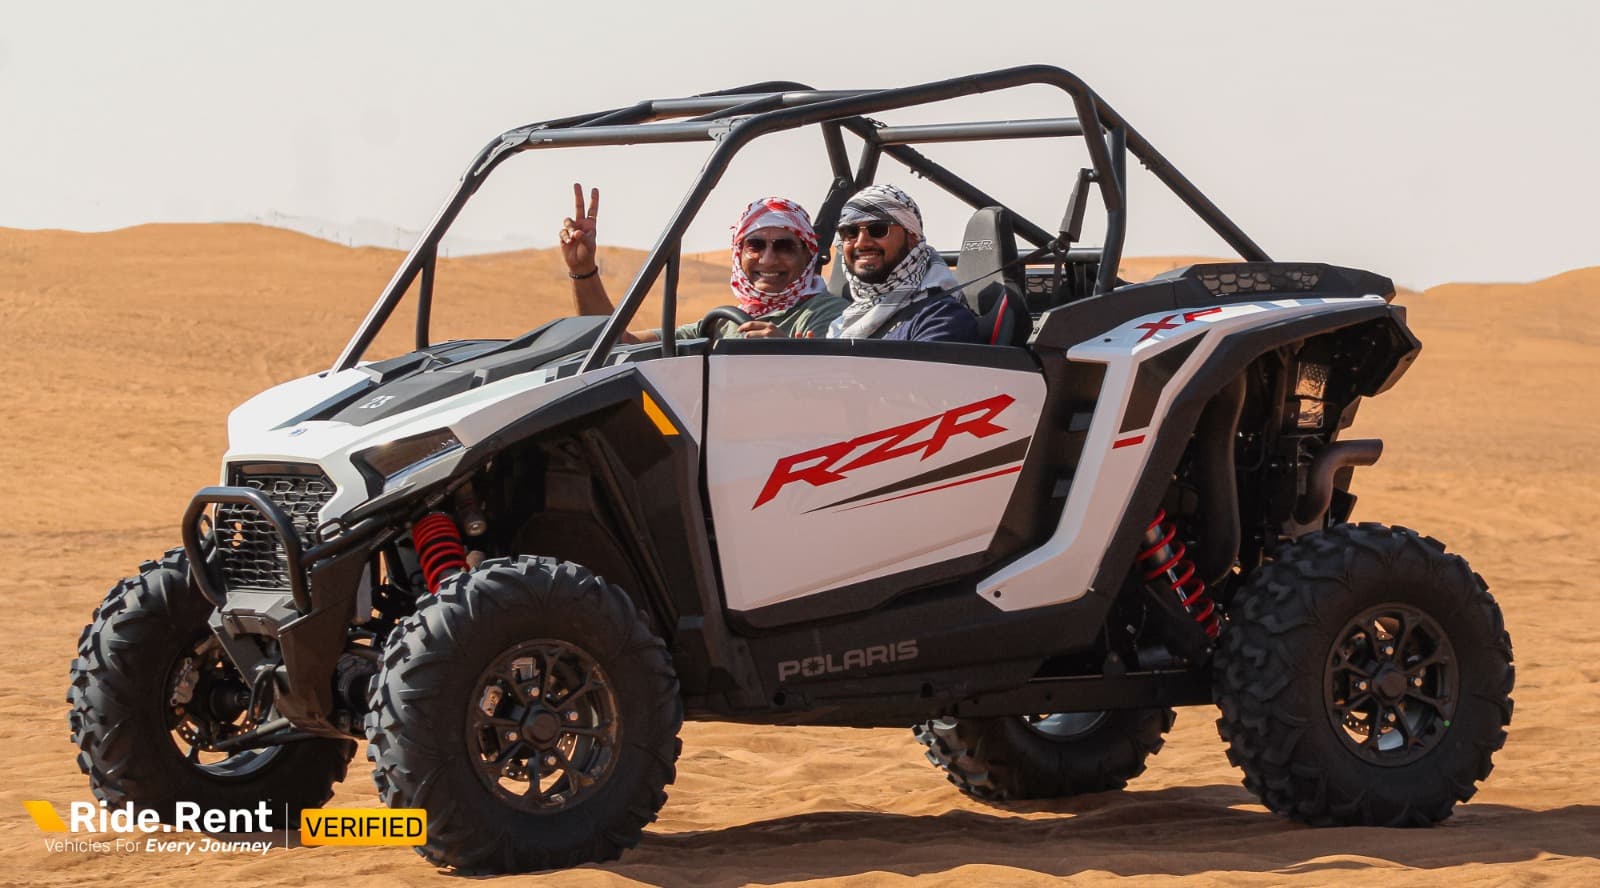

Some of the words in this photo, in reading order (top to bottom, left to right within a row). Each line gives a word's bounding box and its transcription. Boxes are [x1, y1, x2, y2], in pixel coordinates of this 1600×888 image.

[962, 239, 993, 251] RZR
[752, 393, 1016, 511] RZR
[777, 639, 919, 682] POLARIS
